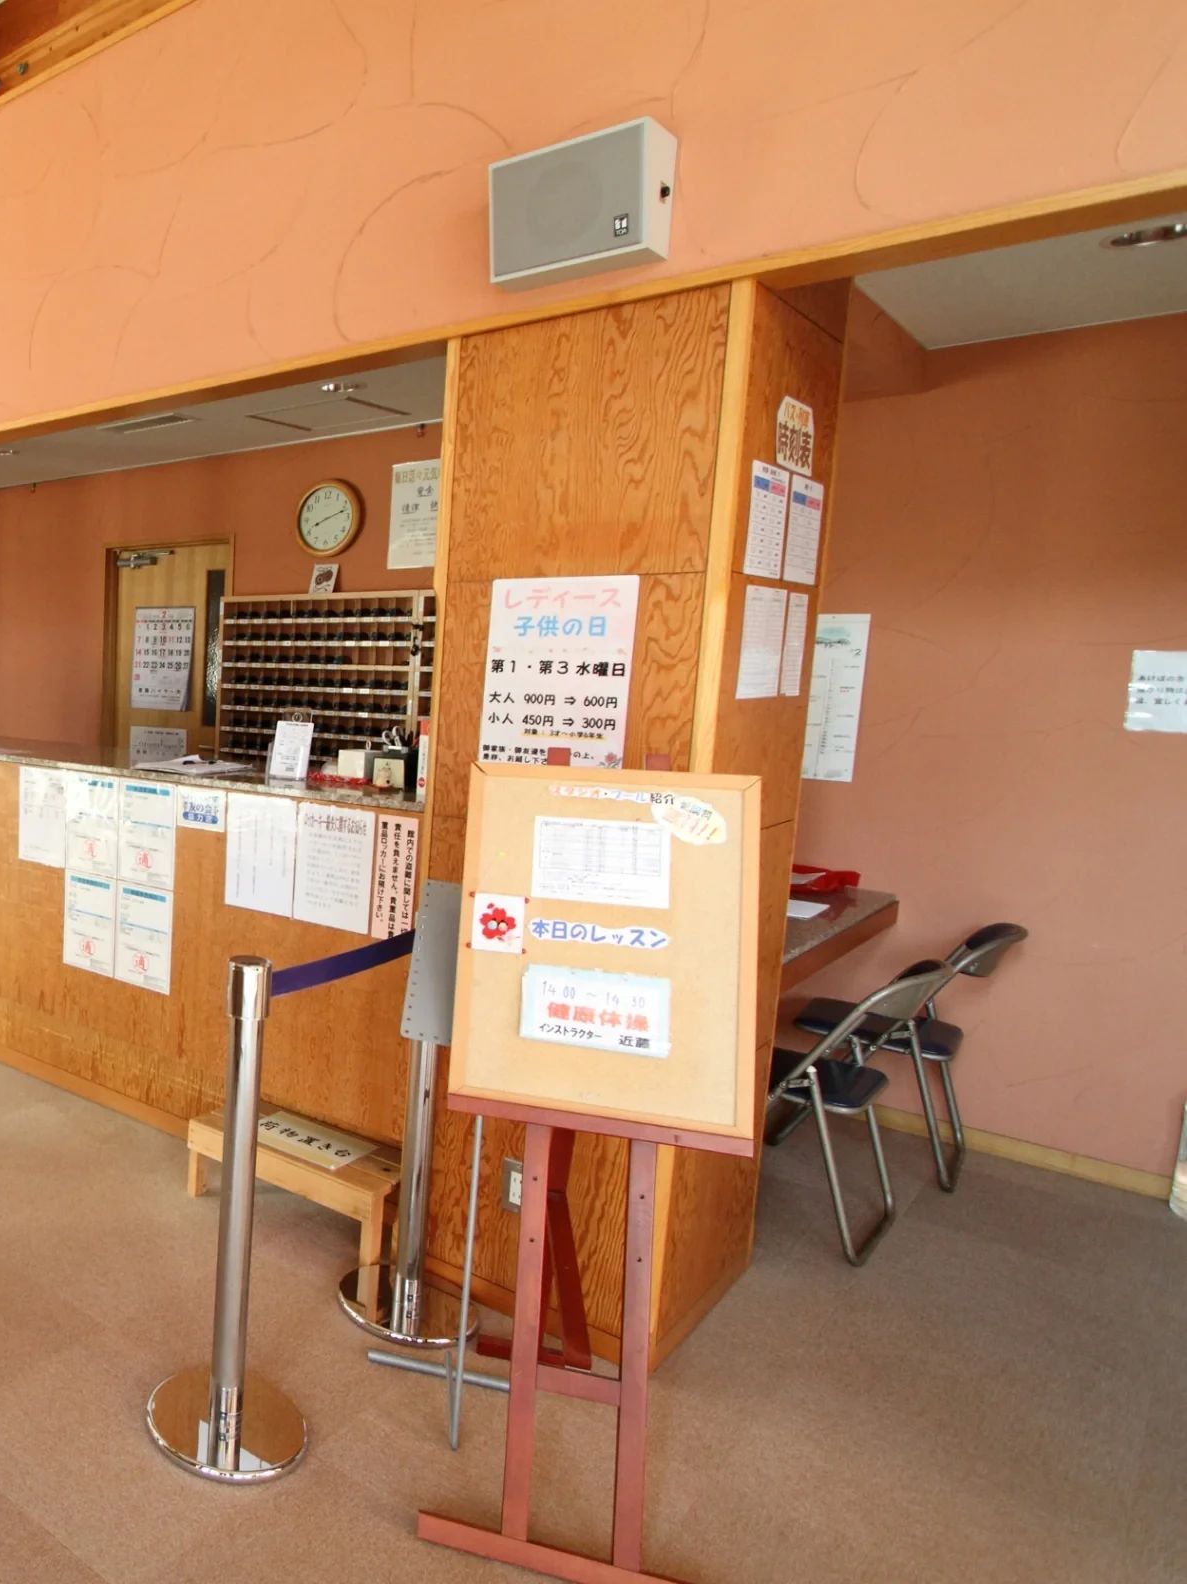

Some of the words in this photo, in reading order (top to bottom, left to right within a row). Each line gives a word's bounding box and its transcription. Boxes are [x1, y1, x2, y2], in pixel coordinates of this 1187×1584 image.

[778, 421, 812, 469] 時刻表
[504, 587, 621, 609] レディース
[514, 615, 606, 637] 子供の日
[489, 691, 515, 704] 大人
[524, 694, 556, 706] 900円
[583, 696, 618, 708] 600円
[488, 712, 514, 725] 小人
[522, 714, 554, 727] 450円
[582, 718, 616, 730] 300円
[532, 920, 666, 948] 本日のレッスン
[547, 1001, 650, 1032] 健康体操
[539, 1023, 602, 1040] インストラクター
[618, 1034, 650, 1049] 近藤
